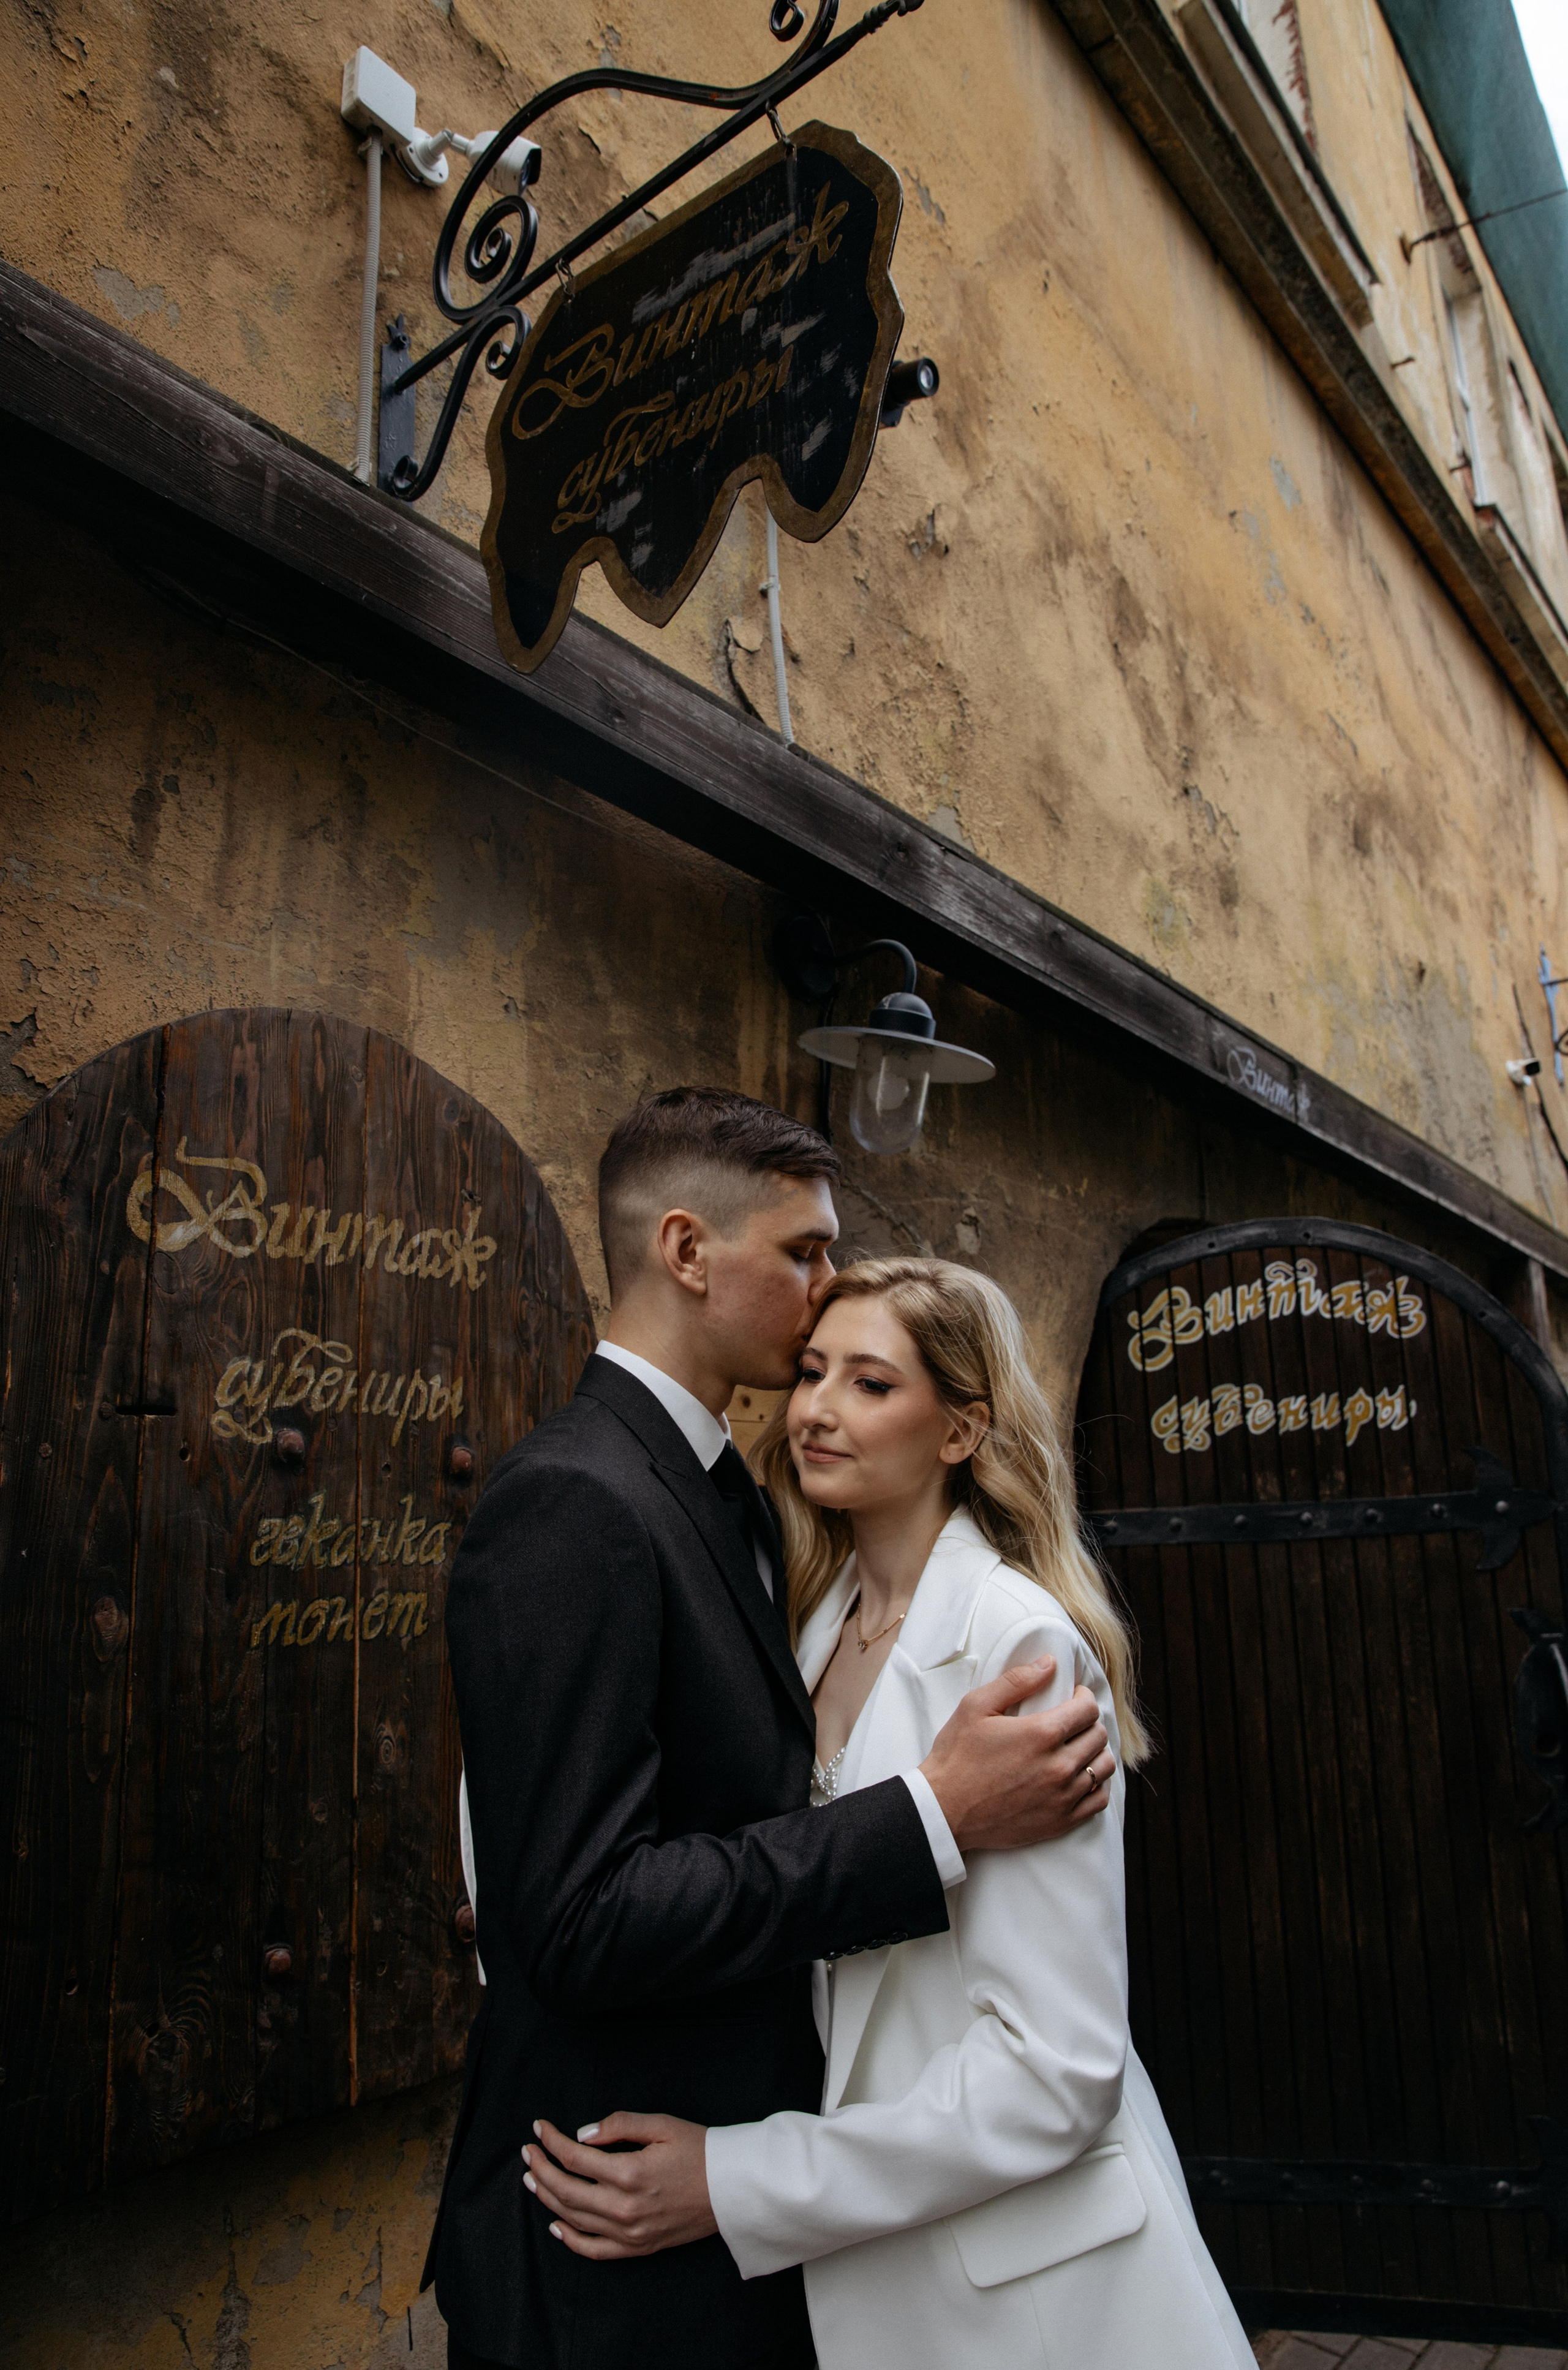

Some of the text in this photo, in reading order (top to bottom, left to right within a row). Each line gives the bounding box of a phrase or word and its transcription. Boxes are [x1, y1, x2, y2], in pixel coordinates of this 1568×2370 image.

[512, 181, 850, 440] Винтаж
[551, 344, 794, 534] сувениры
[126, 1136, 498, 1291] Винтаж
[1128, 1258, 1427, 1372] Винтаж
[210, 1327, 465, 1446] сувениры
[1151, 1383, 1417, 1454] сувениры
[250, 1590, 429, 1648] монет
